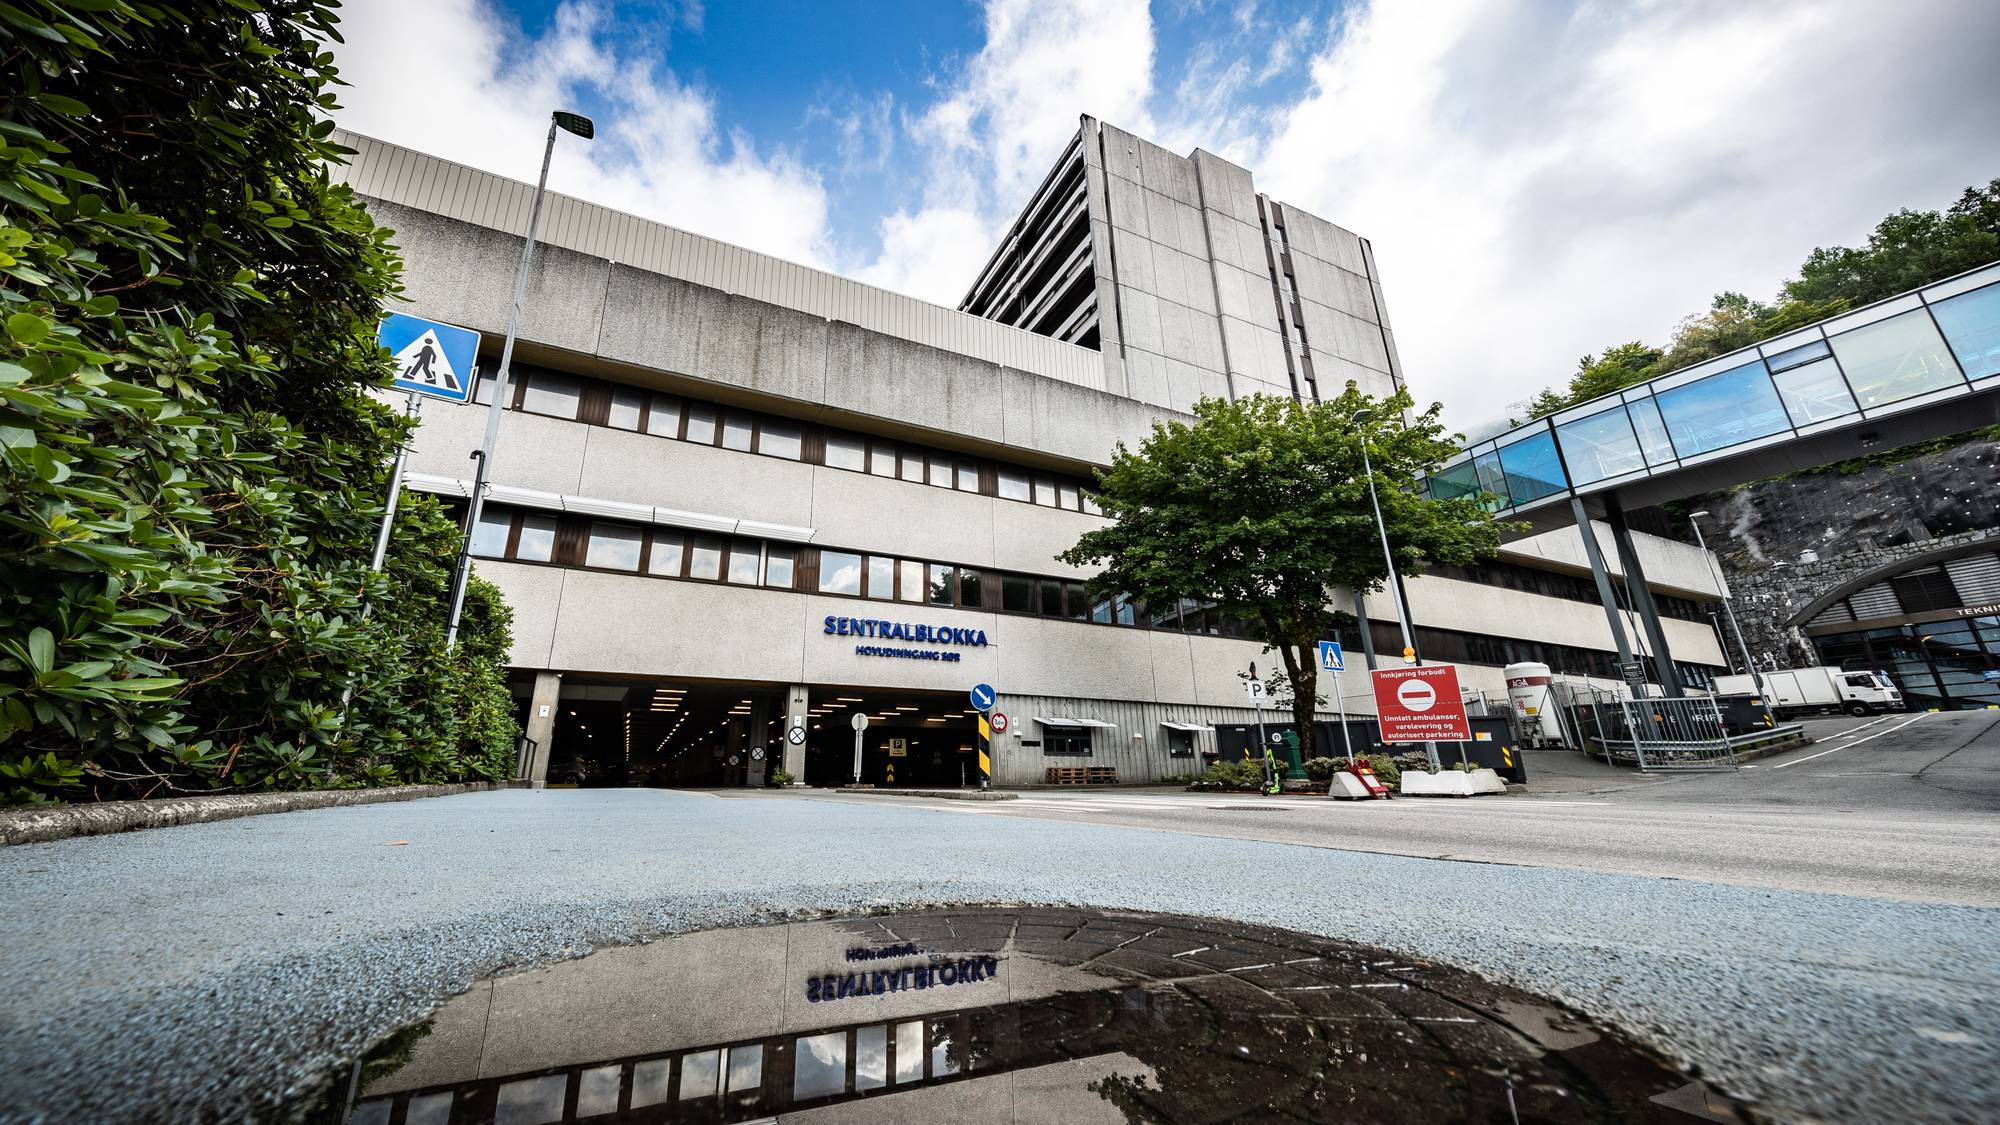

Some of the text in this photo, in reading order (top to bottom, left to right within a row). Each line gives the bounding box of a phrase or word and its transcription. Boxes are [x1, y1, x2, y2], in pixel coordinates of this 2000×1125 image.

[824, 616, 988, 646] SENTRALBLOKKA
[855, 645, 961, 662] HOVUDINNGANG SØR
[1512, 678, 1529, 687] AGA
[1252, 684, 1261, 696] P
[1425, 731, 1464, 739] parkering
